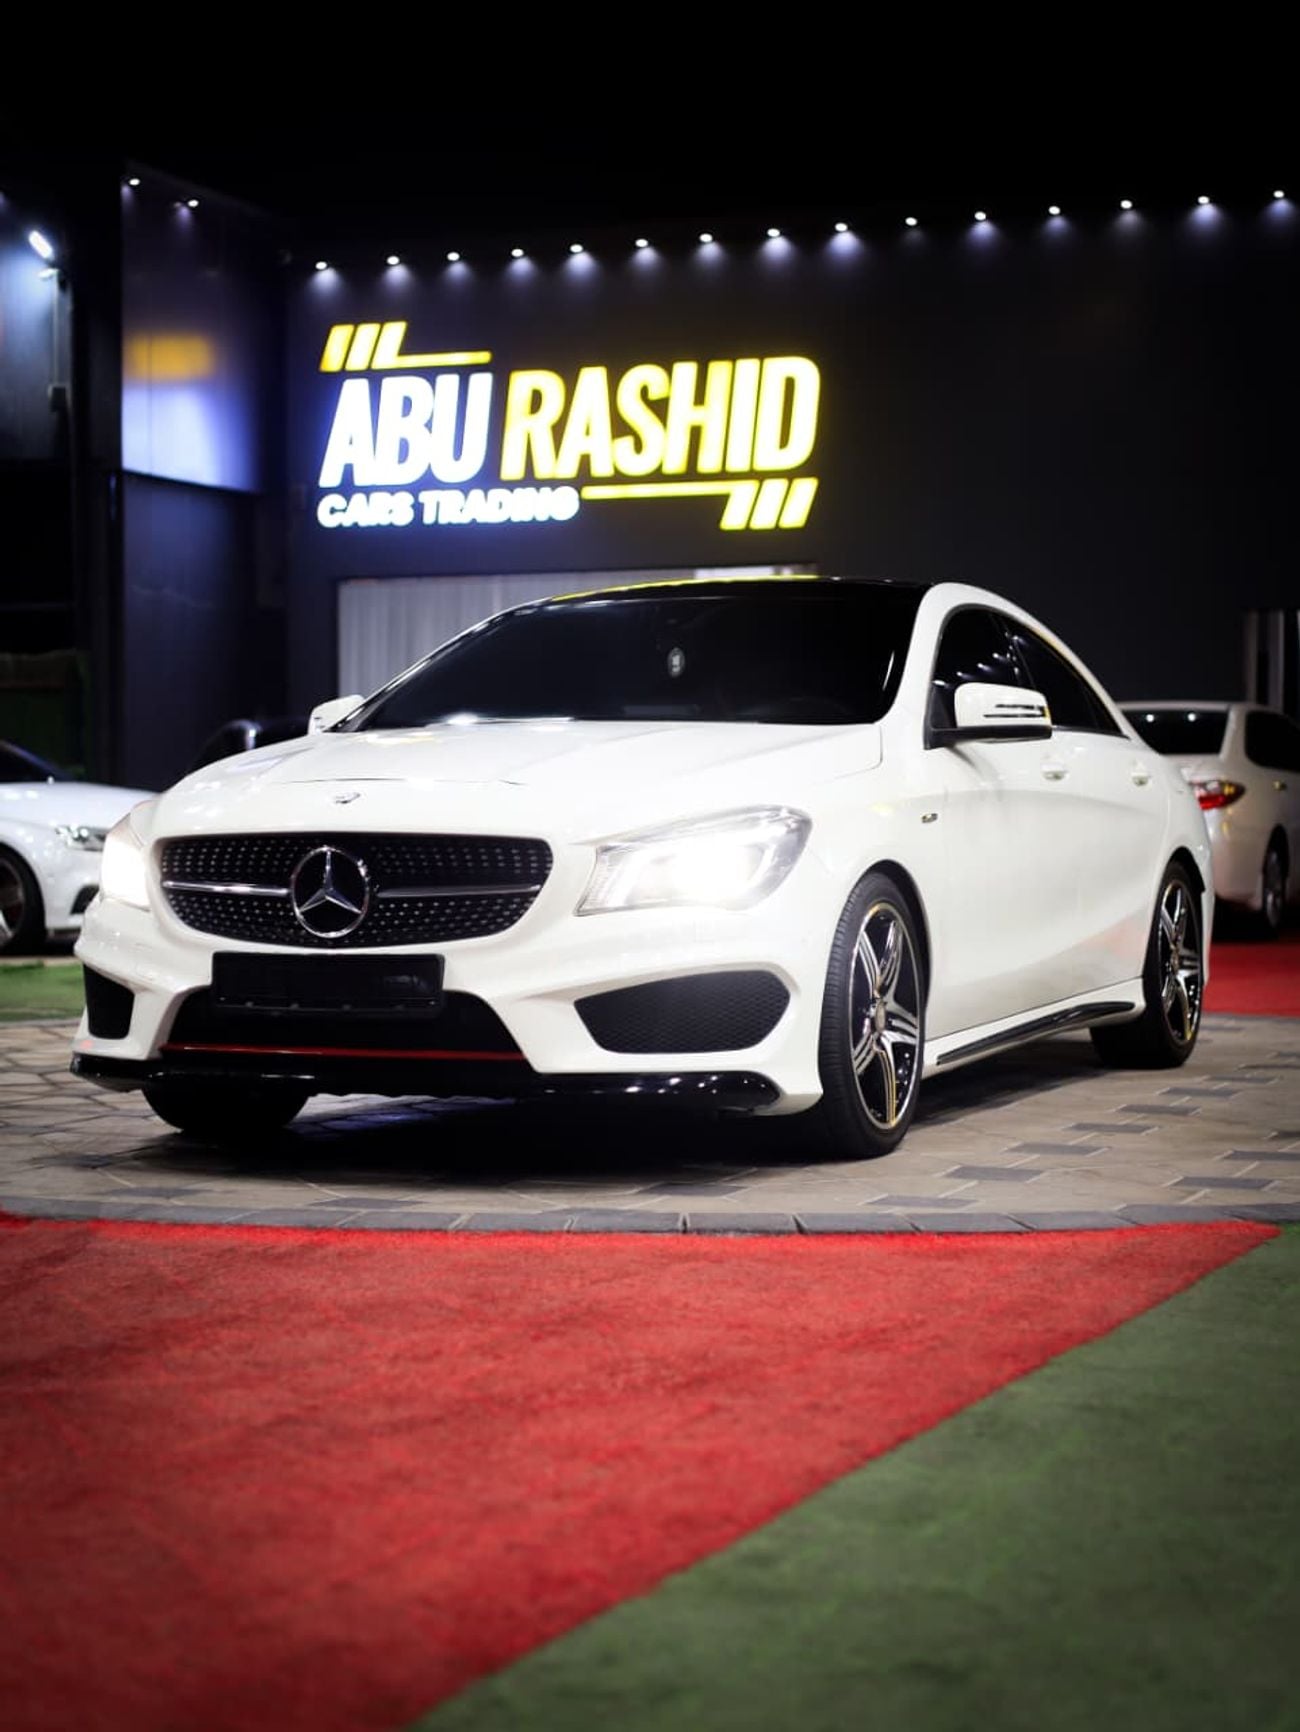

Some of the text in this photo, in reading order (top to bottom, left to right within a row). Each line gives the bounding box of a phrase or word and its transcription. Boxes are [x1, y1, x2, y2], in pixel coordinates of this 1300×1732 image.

[319, 356, 820, 488] ABU RASHID
[317, 486, 580, 527] CARS TRADING
